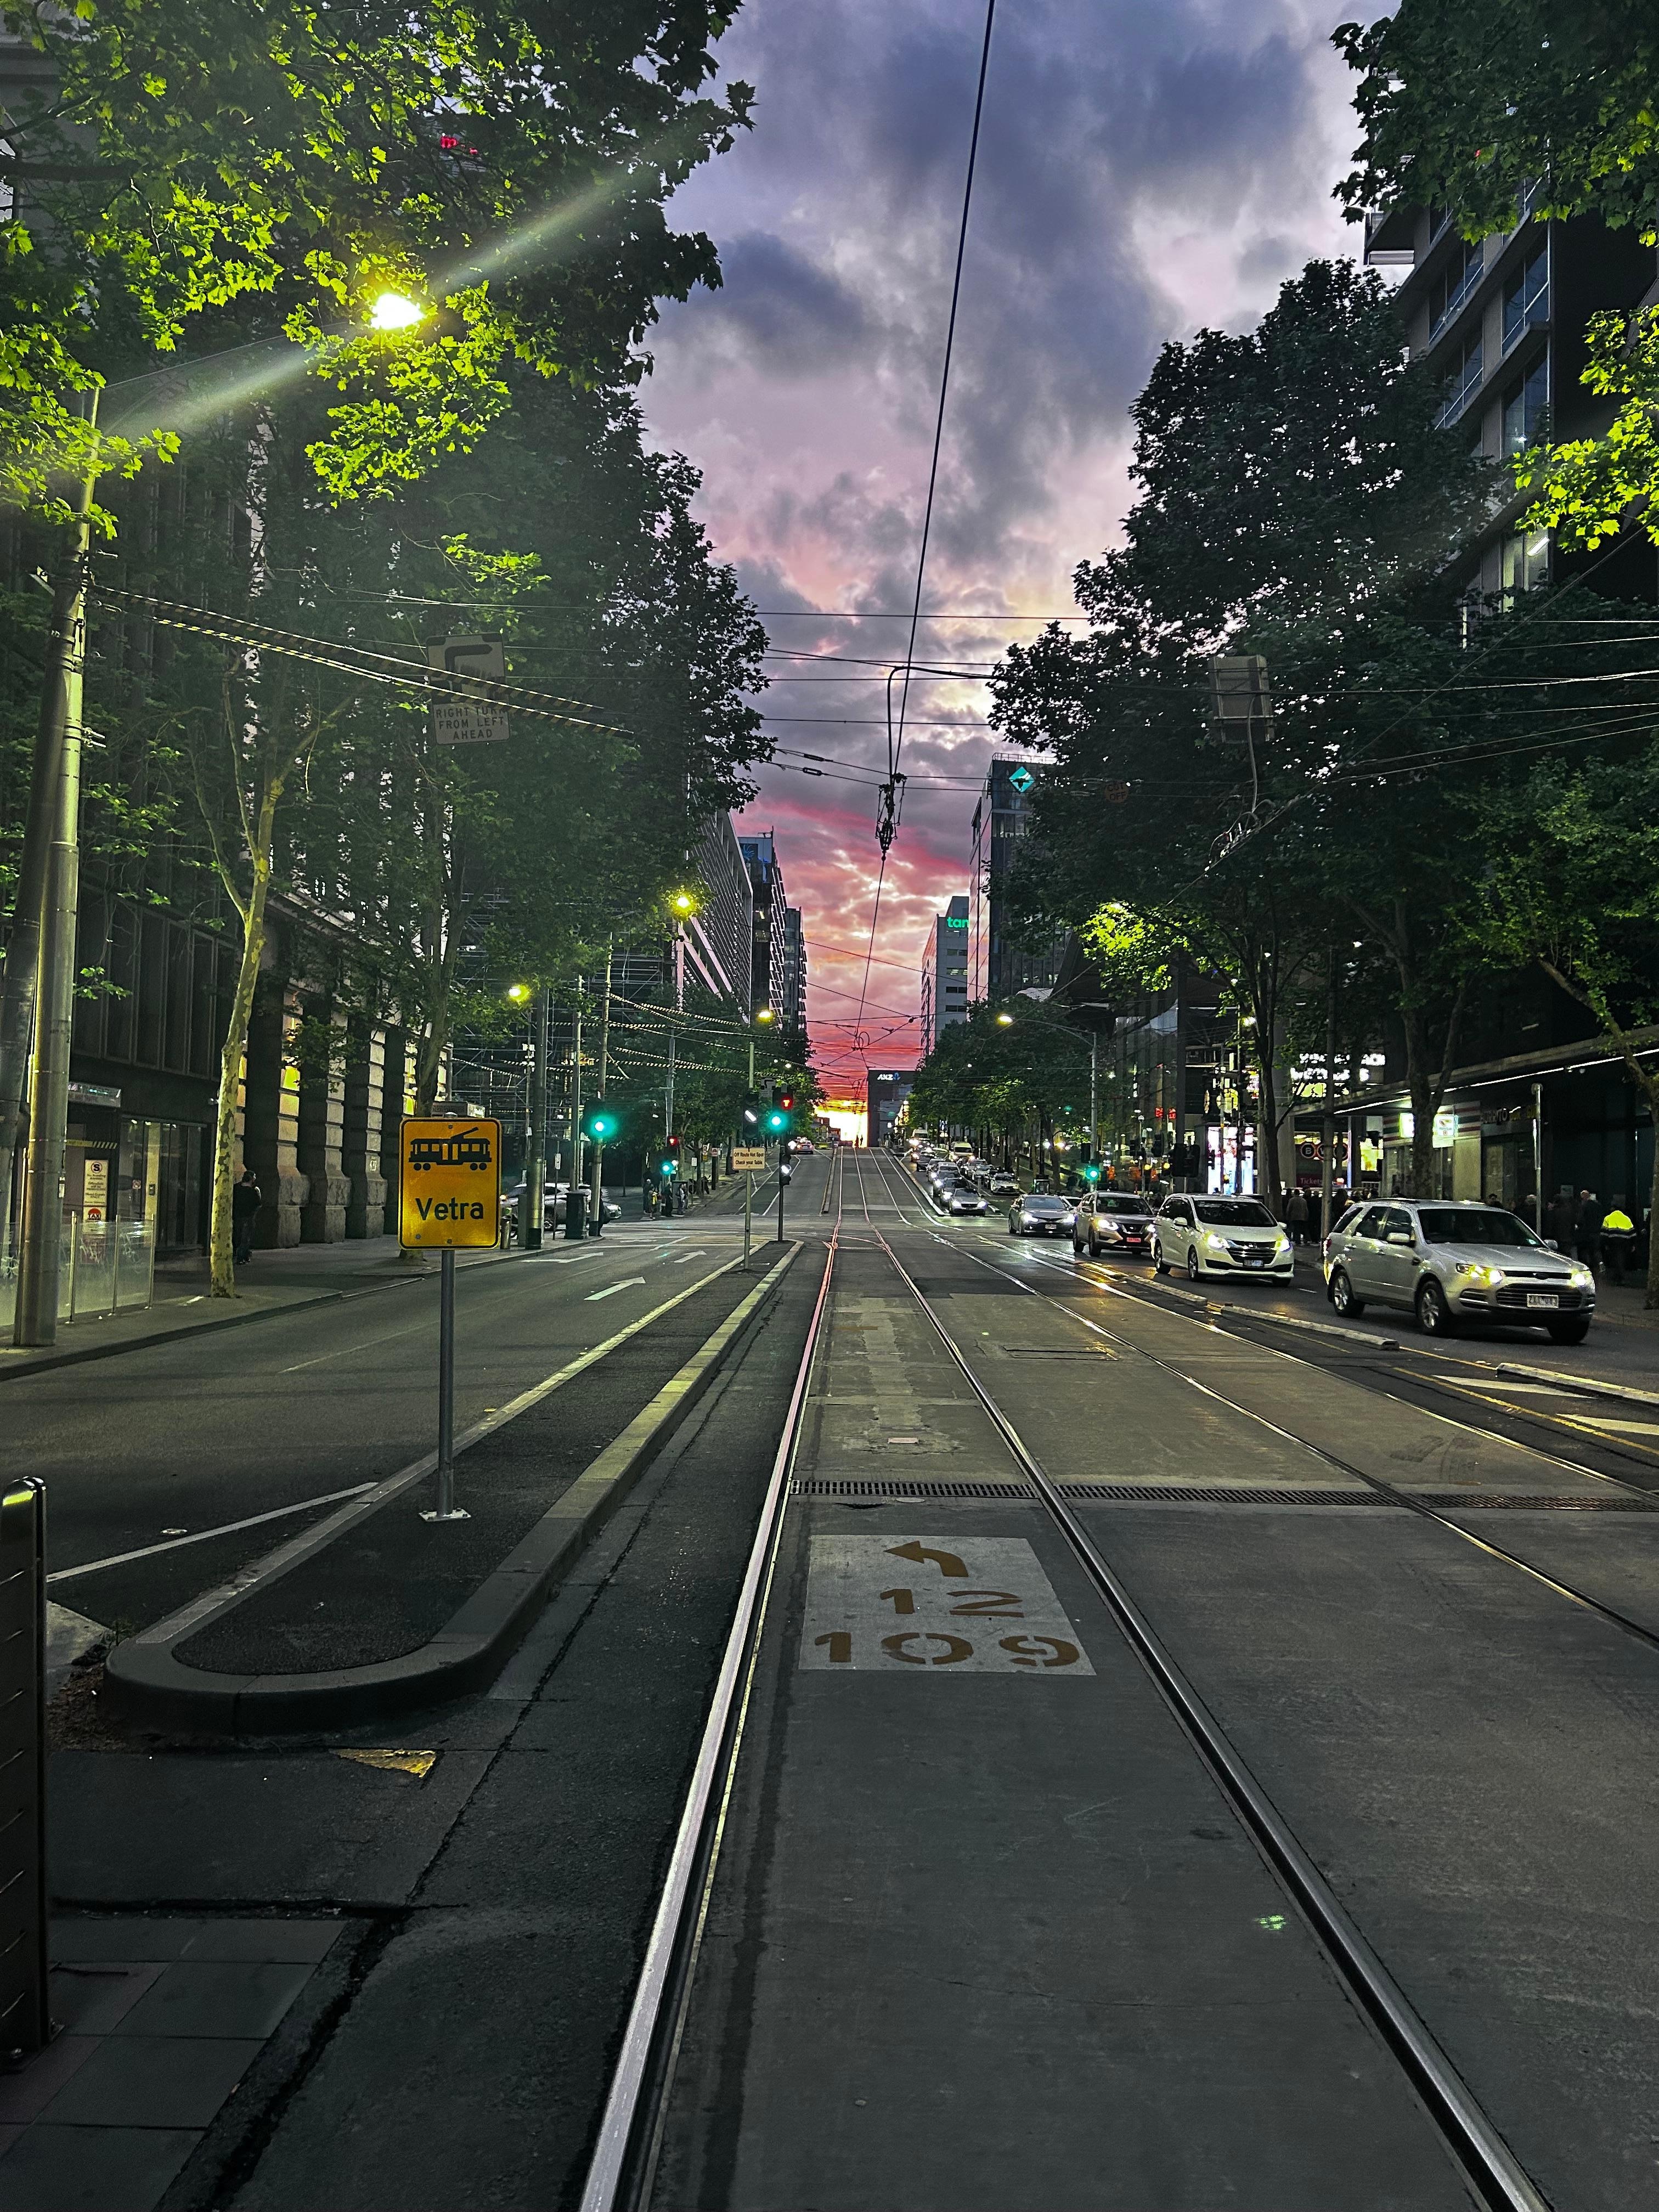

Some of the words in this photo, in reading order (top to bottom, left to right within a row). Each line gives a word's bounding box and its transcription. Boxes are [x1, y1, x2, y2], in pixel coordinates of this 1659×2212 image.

[436, 707, 469, 719] RIGHT
[439, 719, 469, 730] FROM
[477, 716, 504, 727] LEFT
[453, 729, 493, 740] AHEAD
[415, 1197, 484, 1221] Vetra
[879, 1588, 1025, 1618] 12
[815, 1632, 1081, 1667] 109
